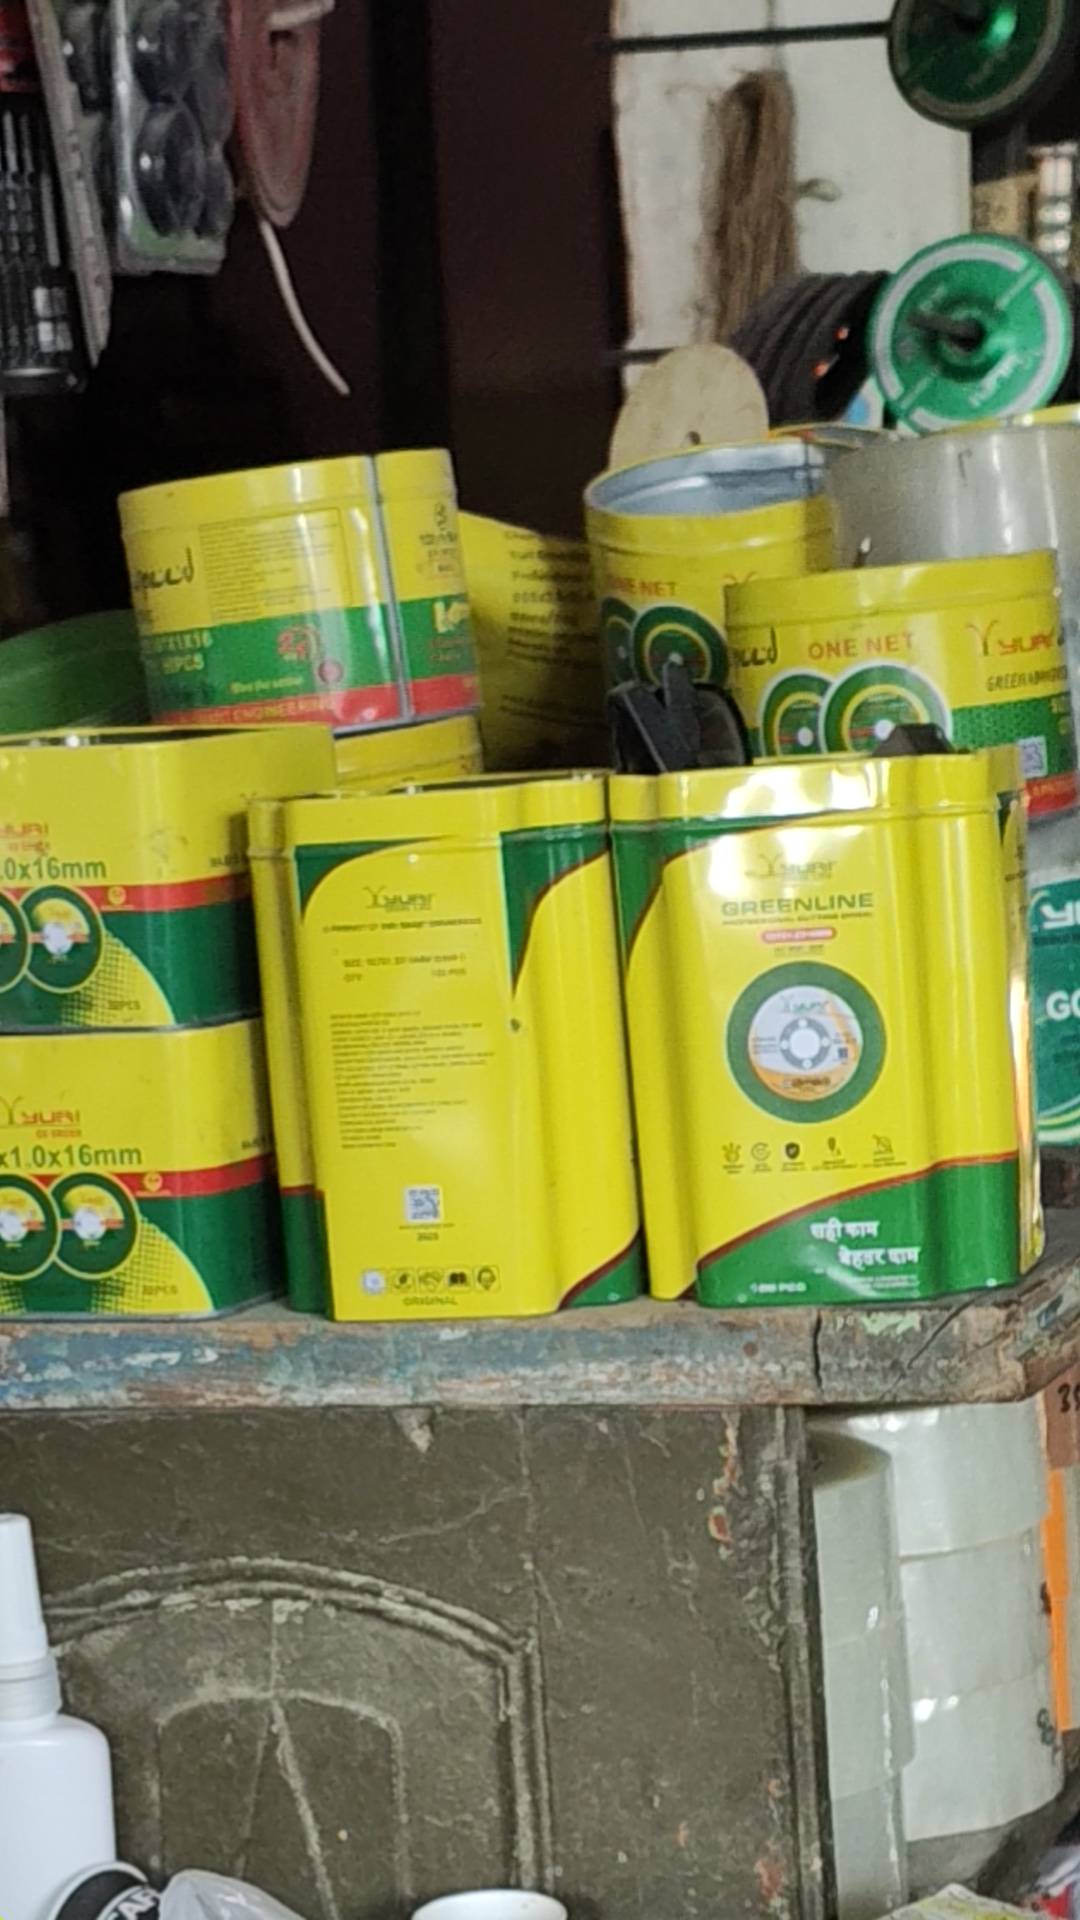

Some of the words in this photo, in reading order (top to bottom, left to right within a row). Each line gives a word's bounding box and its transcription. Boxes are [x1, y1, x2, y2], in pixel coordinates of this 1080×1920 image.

[638, 579, 677, 596] NET
[808, 638, 858, 661] ONE
[863, 631, 914, 654] NET
[721, 892, 874, 917] GREENLINE
[1039, 901, 1080, 930] Y
